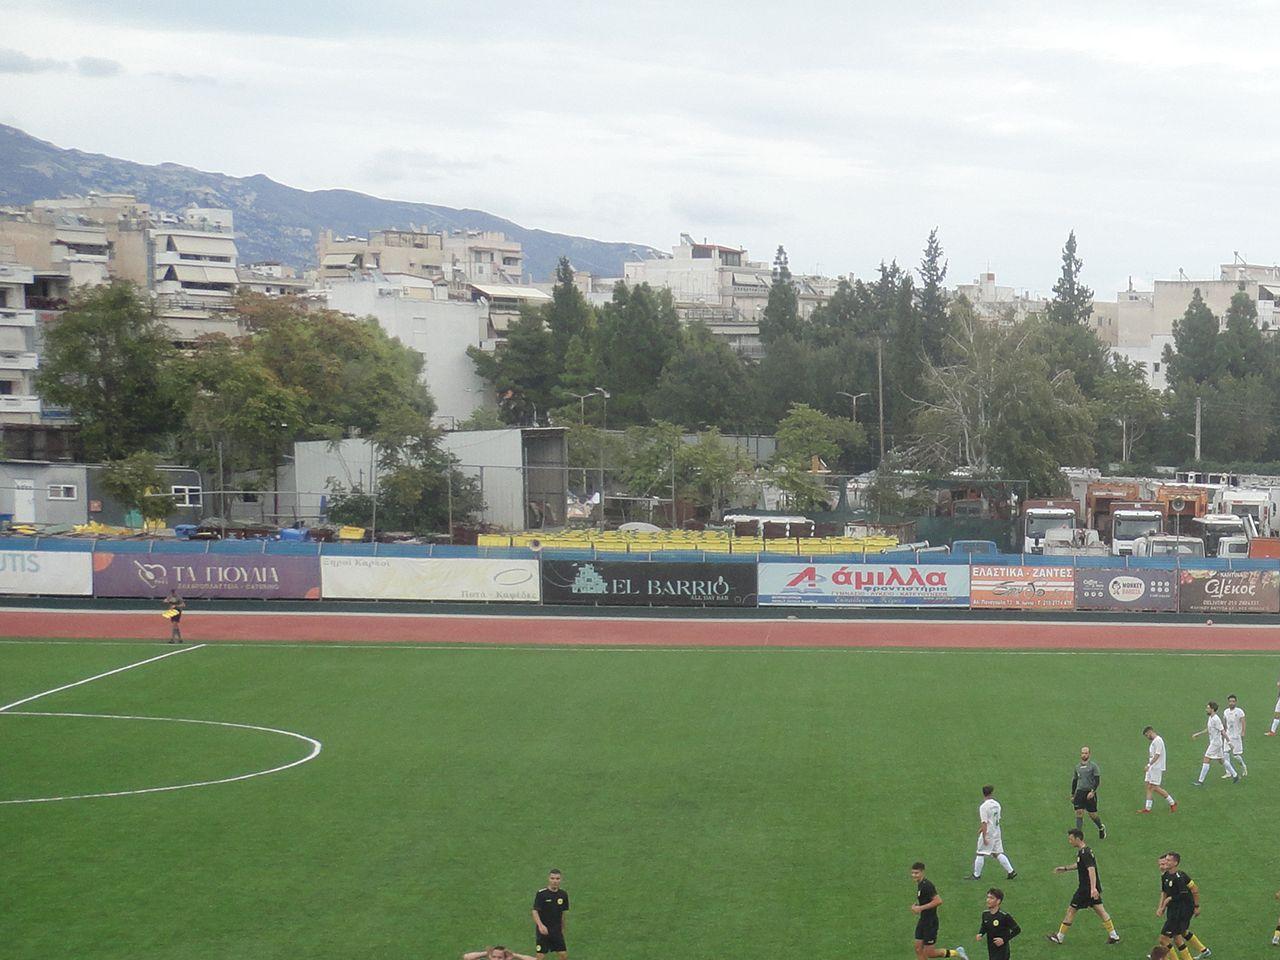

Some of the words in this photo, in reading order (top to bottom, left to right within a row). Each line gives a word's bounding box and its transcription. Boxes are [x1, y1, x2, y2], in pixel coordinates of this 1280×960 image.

[831, 566, 947, 590] άμιλλα
[972, 567, 1024, 578] ΕΛΑΣΤΙΚΑ
[1032, 568, 1073, 579] ΖΑΝΤΕΣ
[612, 579, 640, 595] EL
